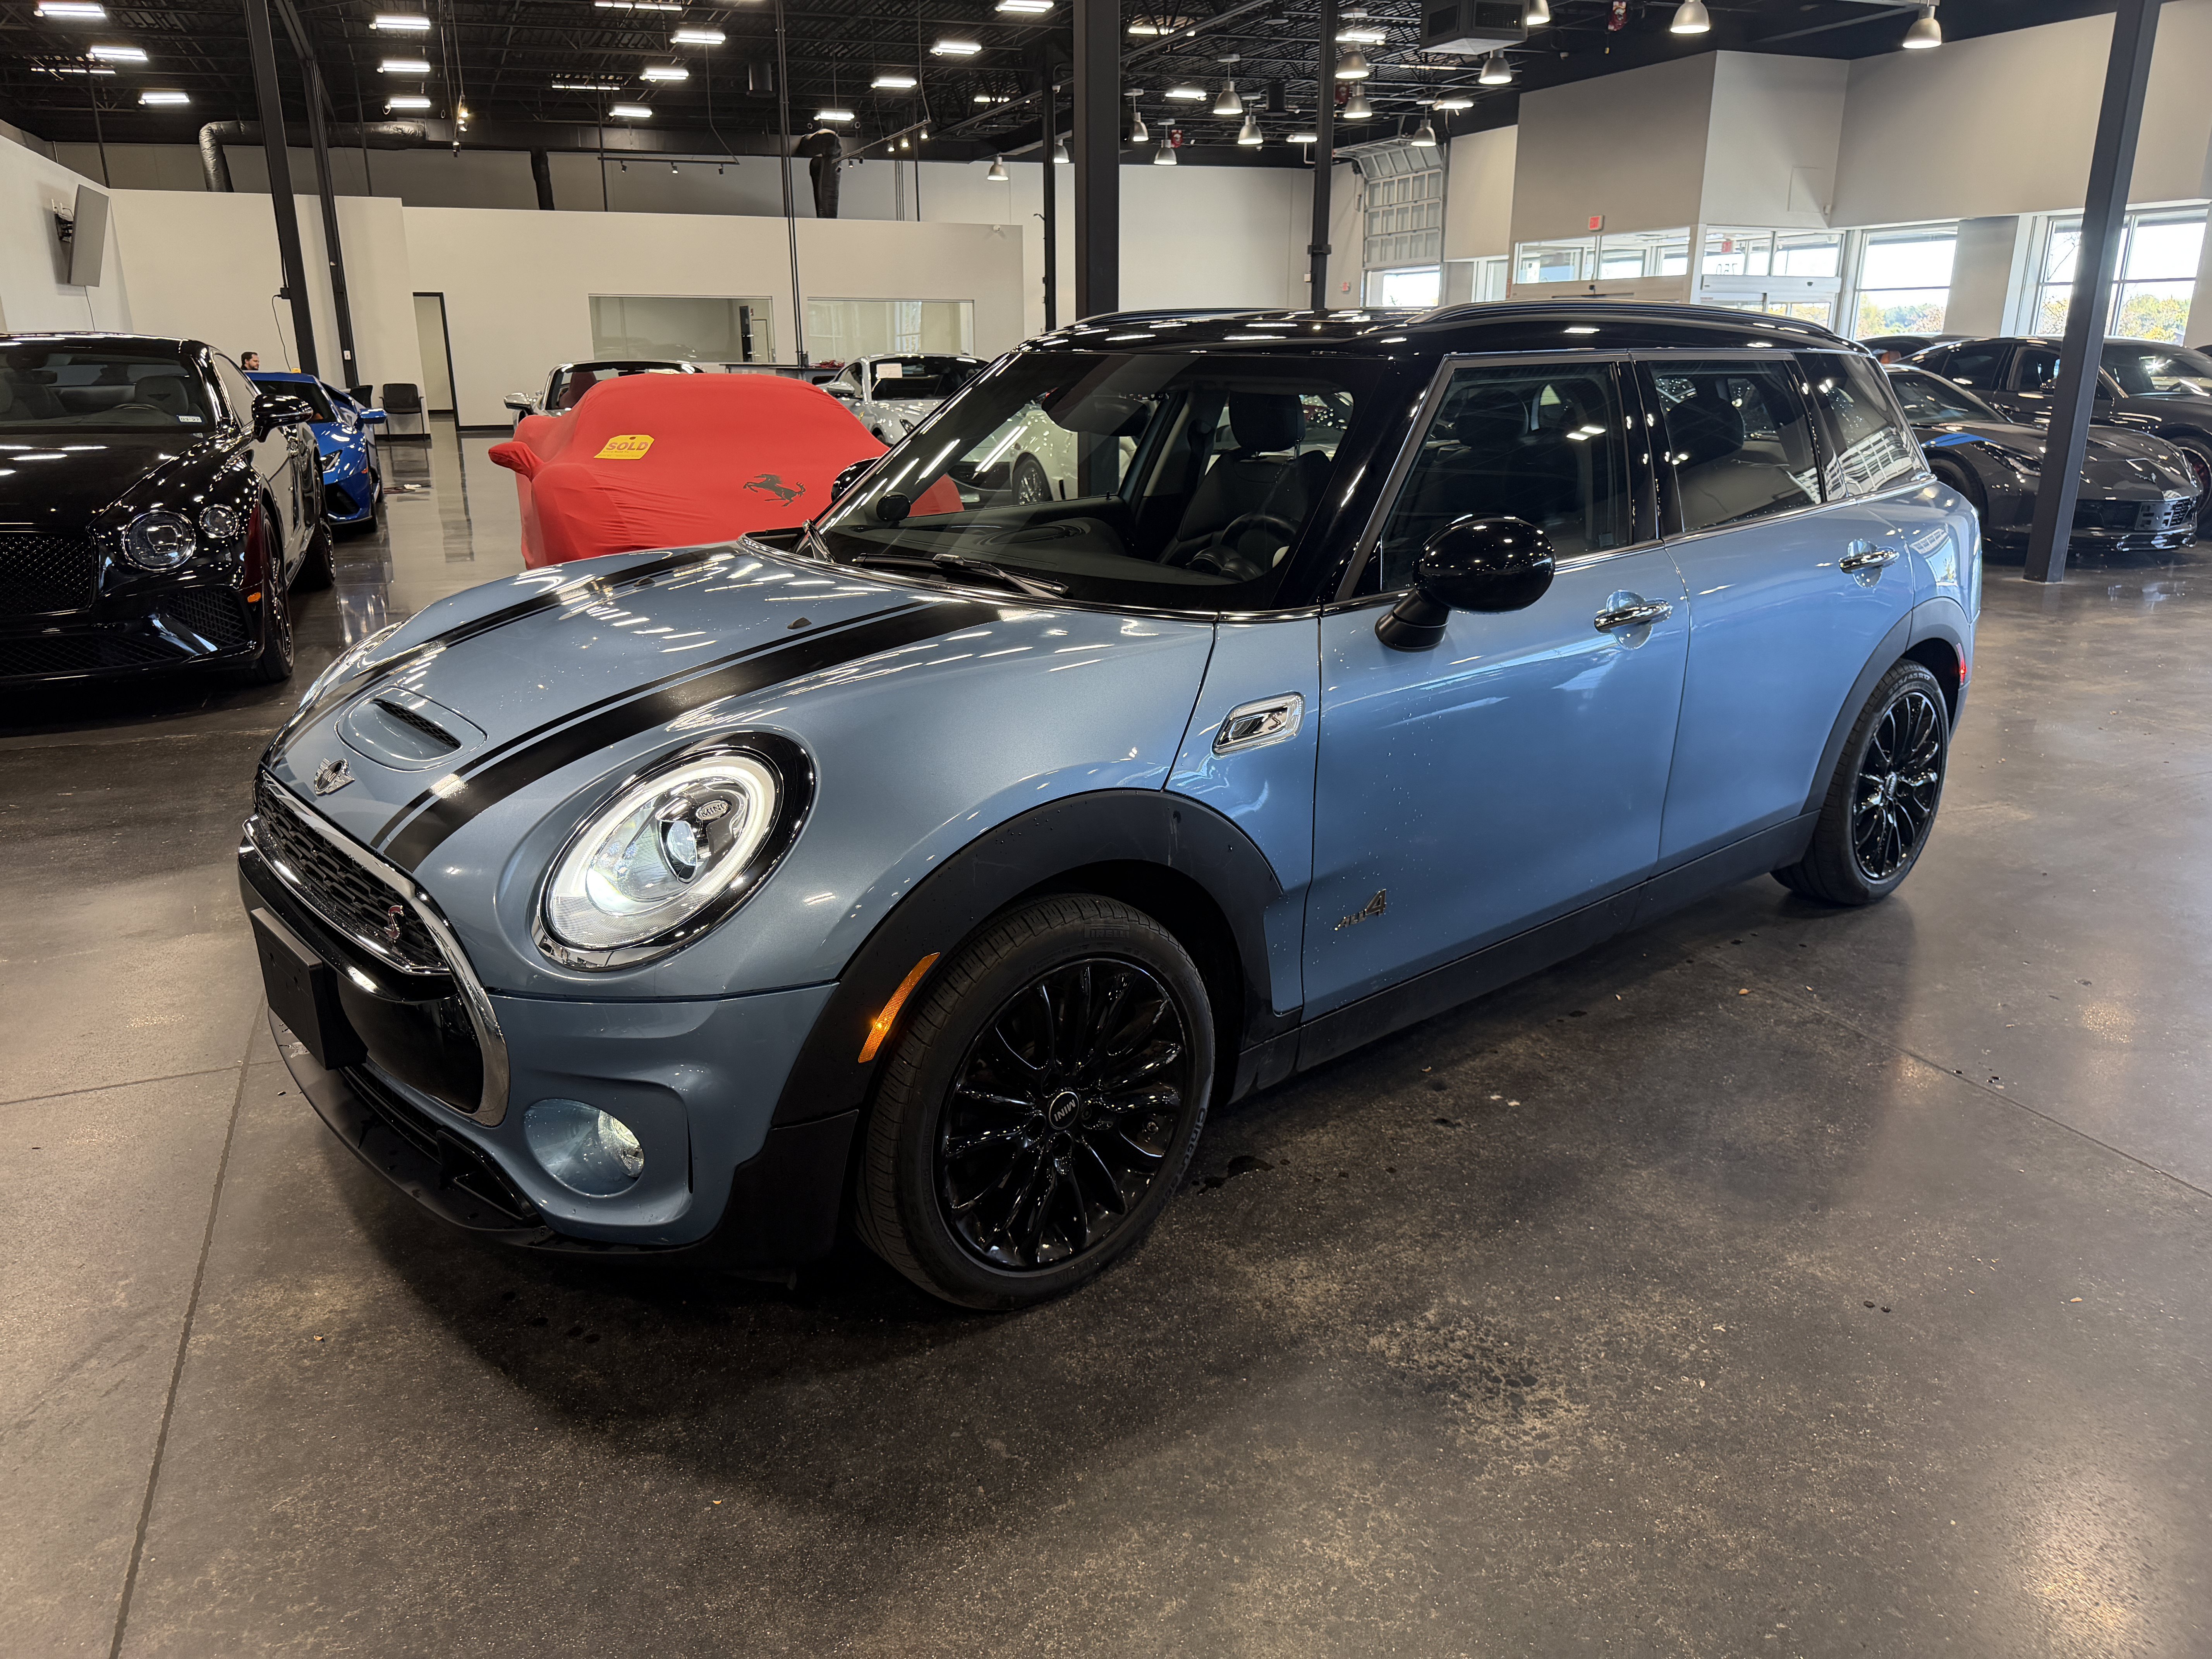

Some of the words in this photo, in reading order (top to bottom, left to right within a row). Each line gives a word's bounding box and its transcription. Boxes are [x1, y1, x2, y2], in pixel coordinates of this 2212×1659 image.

[606, 441, 649, 451] SOLD
[700, 804, 726, 818] MINI
[1084, 924, 1130, 939] PIRELLI
[1053, 1099, 1077, 1122] MINI
